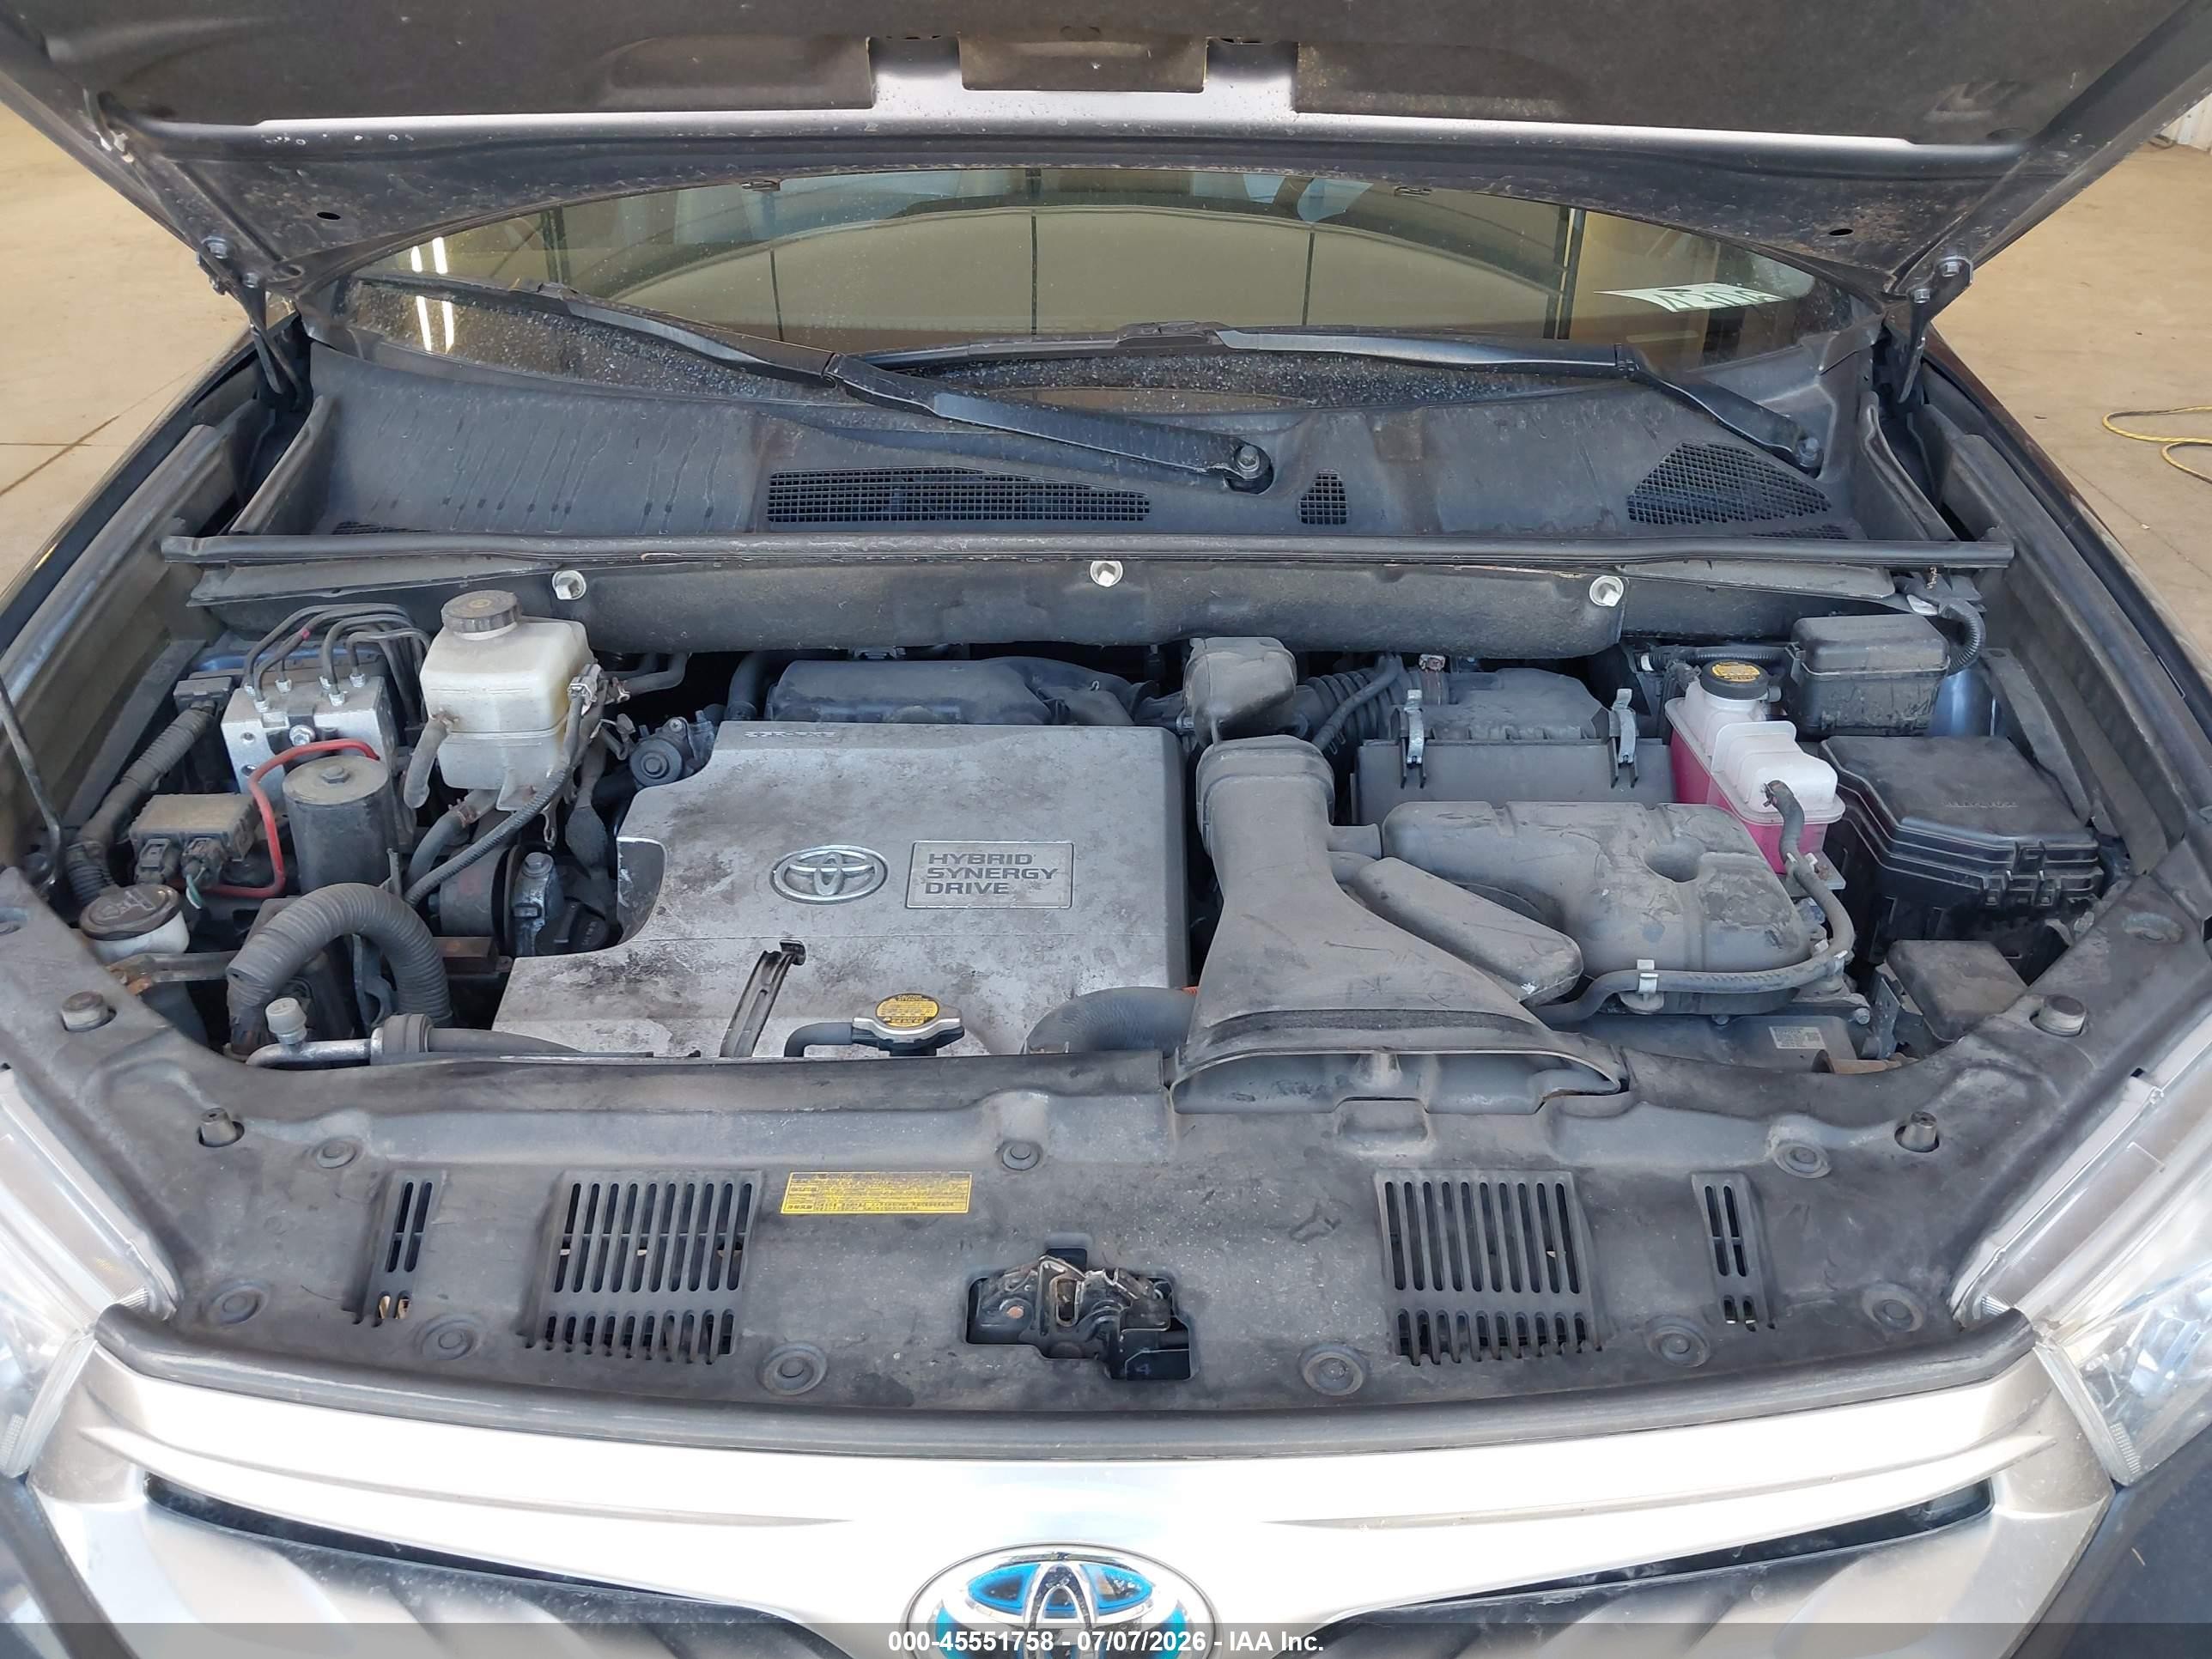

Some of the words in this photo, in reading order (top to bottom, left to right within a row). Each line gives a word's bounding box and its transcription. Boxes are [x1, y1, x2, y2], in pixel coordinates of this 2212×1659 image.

[928, 854, 1033, 866] HYBRID
[927, 867, 1059, 880] SYNERGY
[925, 882, 1011, 895] DRIVE
